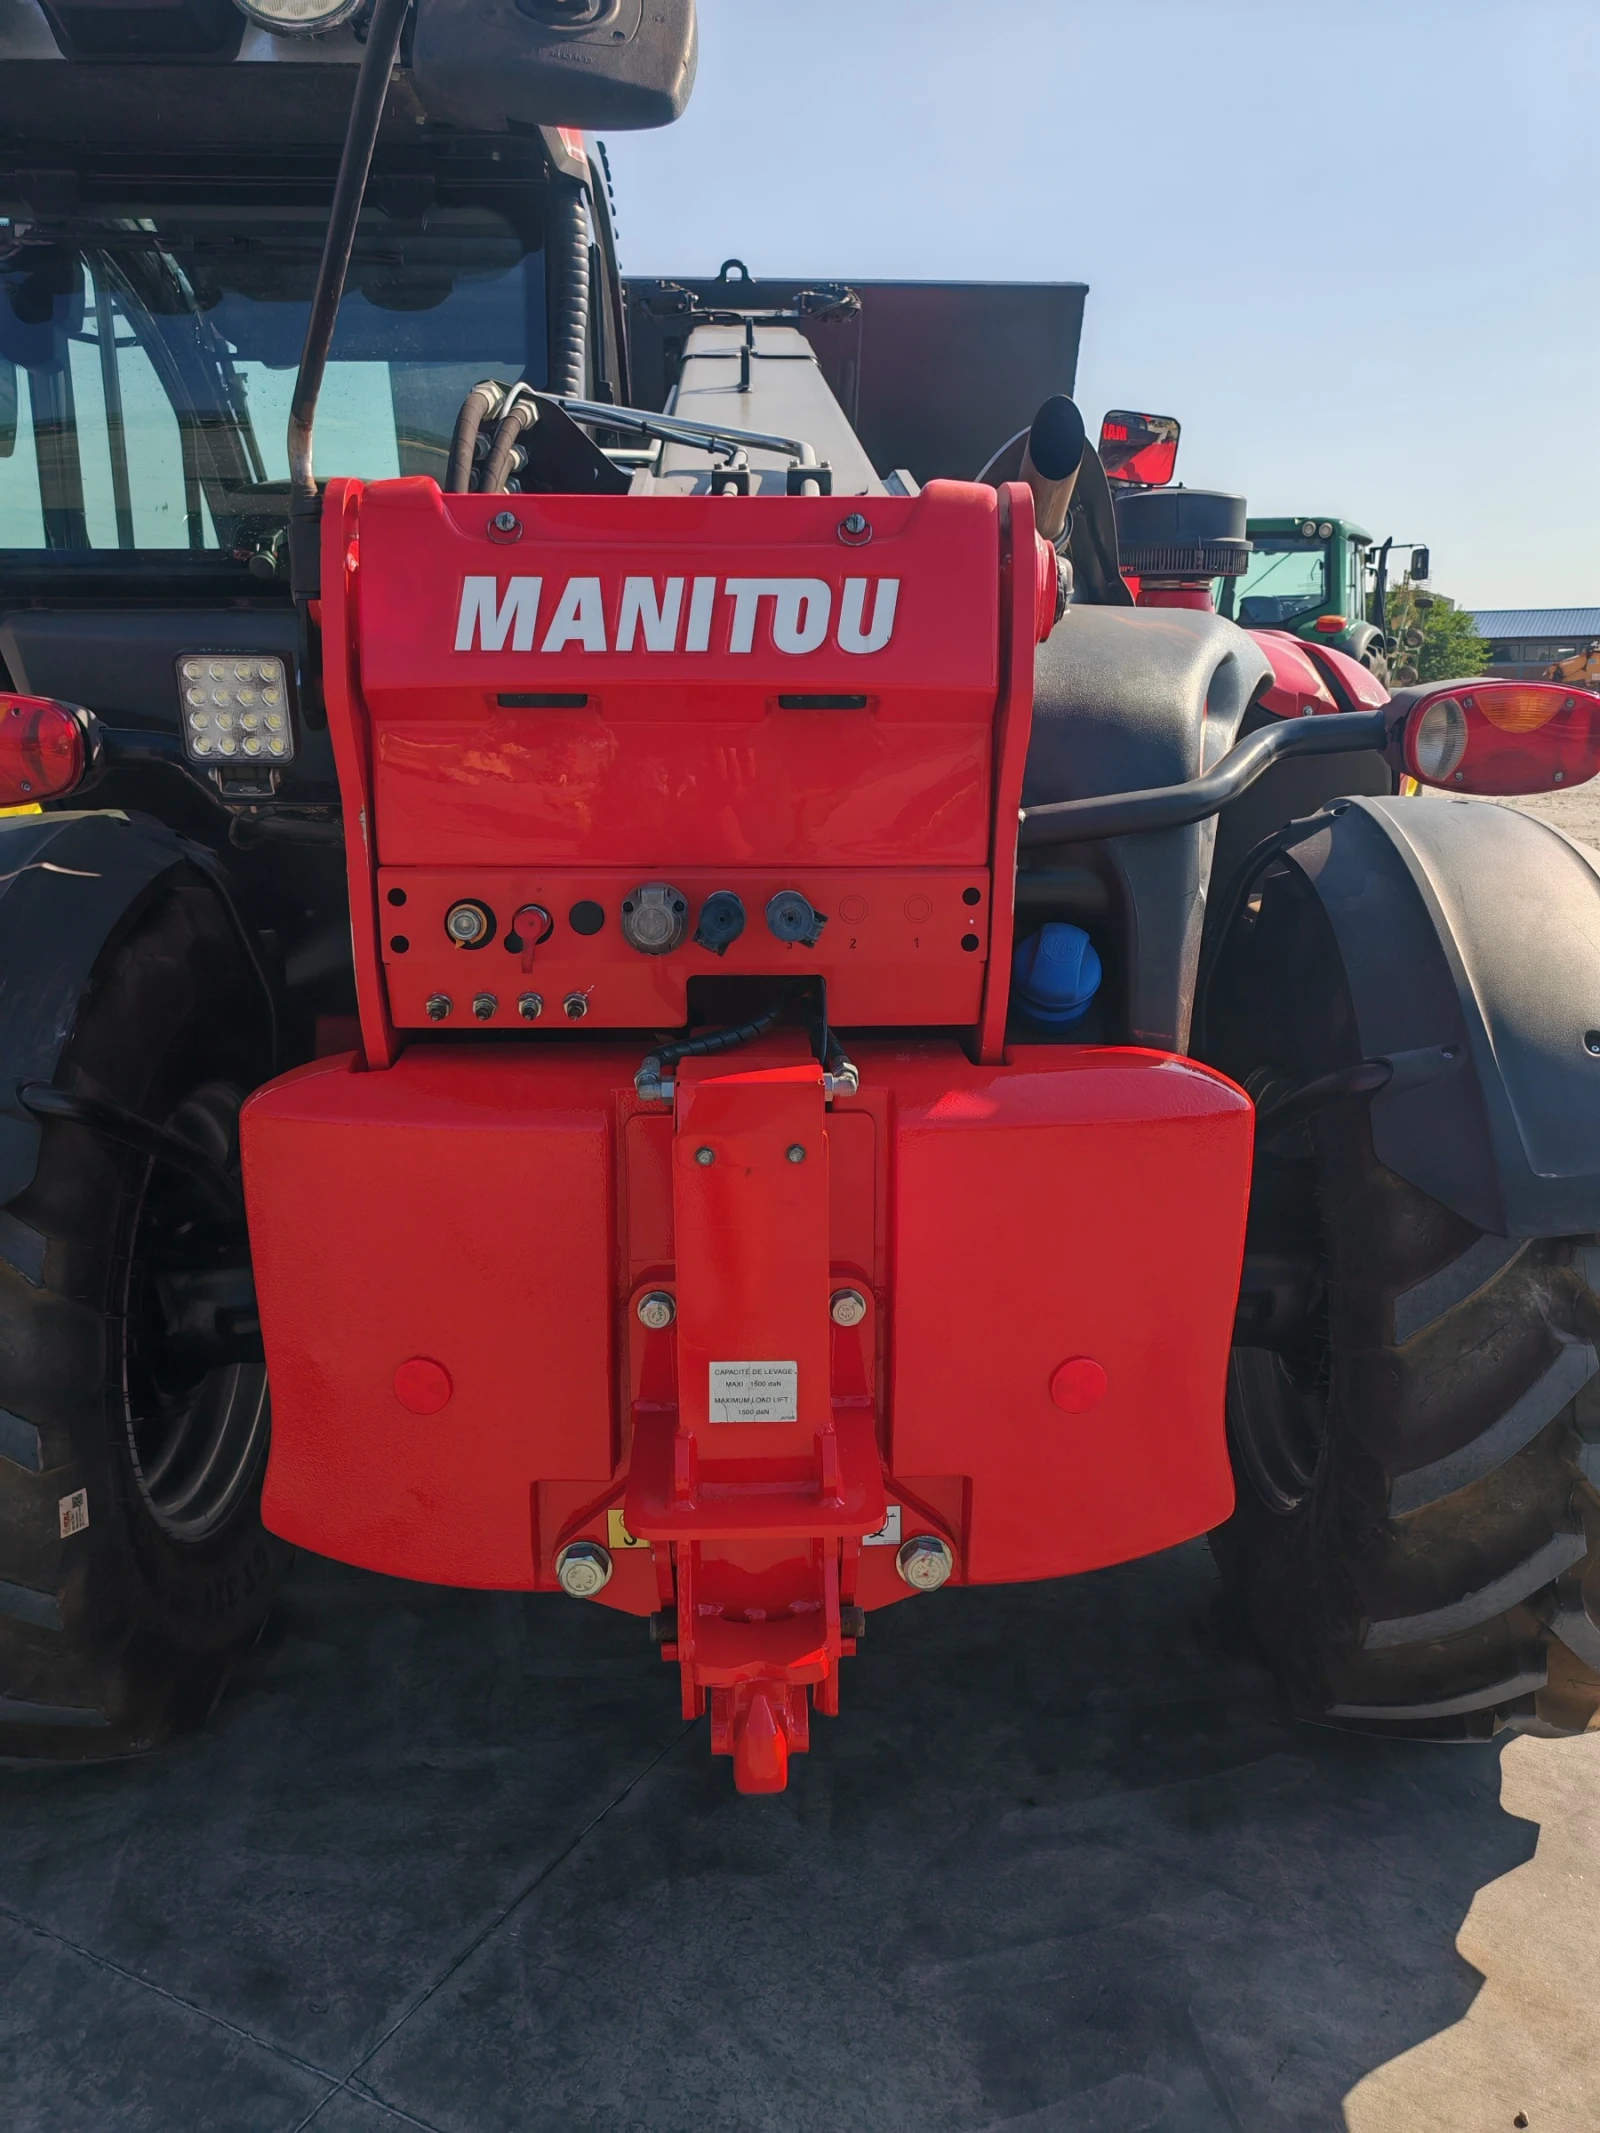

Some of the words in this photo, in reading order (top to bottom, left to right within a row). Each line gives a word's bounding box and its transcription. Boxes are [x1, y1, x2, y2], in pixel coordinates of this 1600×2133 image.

[454, 576, 900, 654] MANITOU
[849, 938, 857, 949] 2
[914, 937, 920, 948] 1
